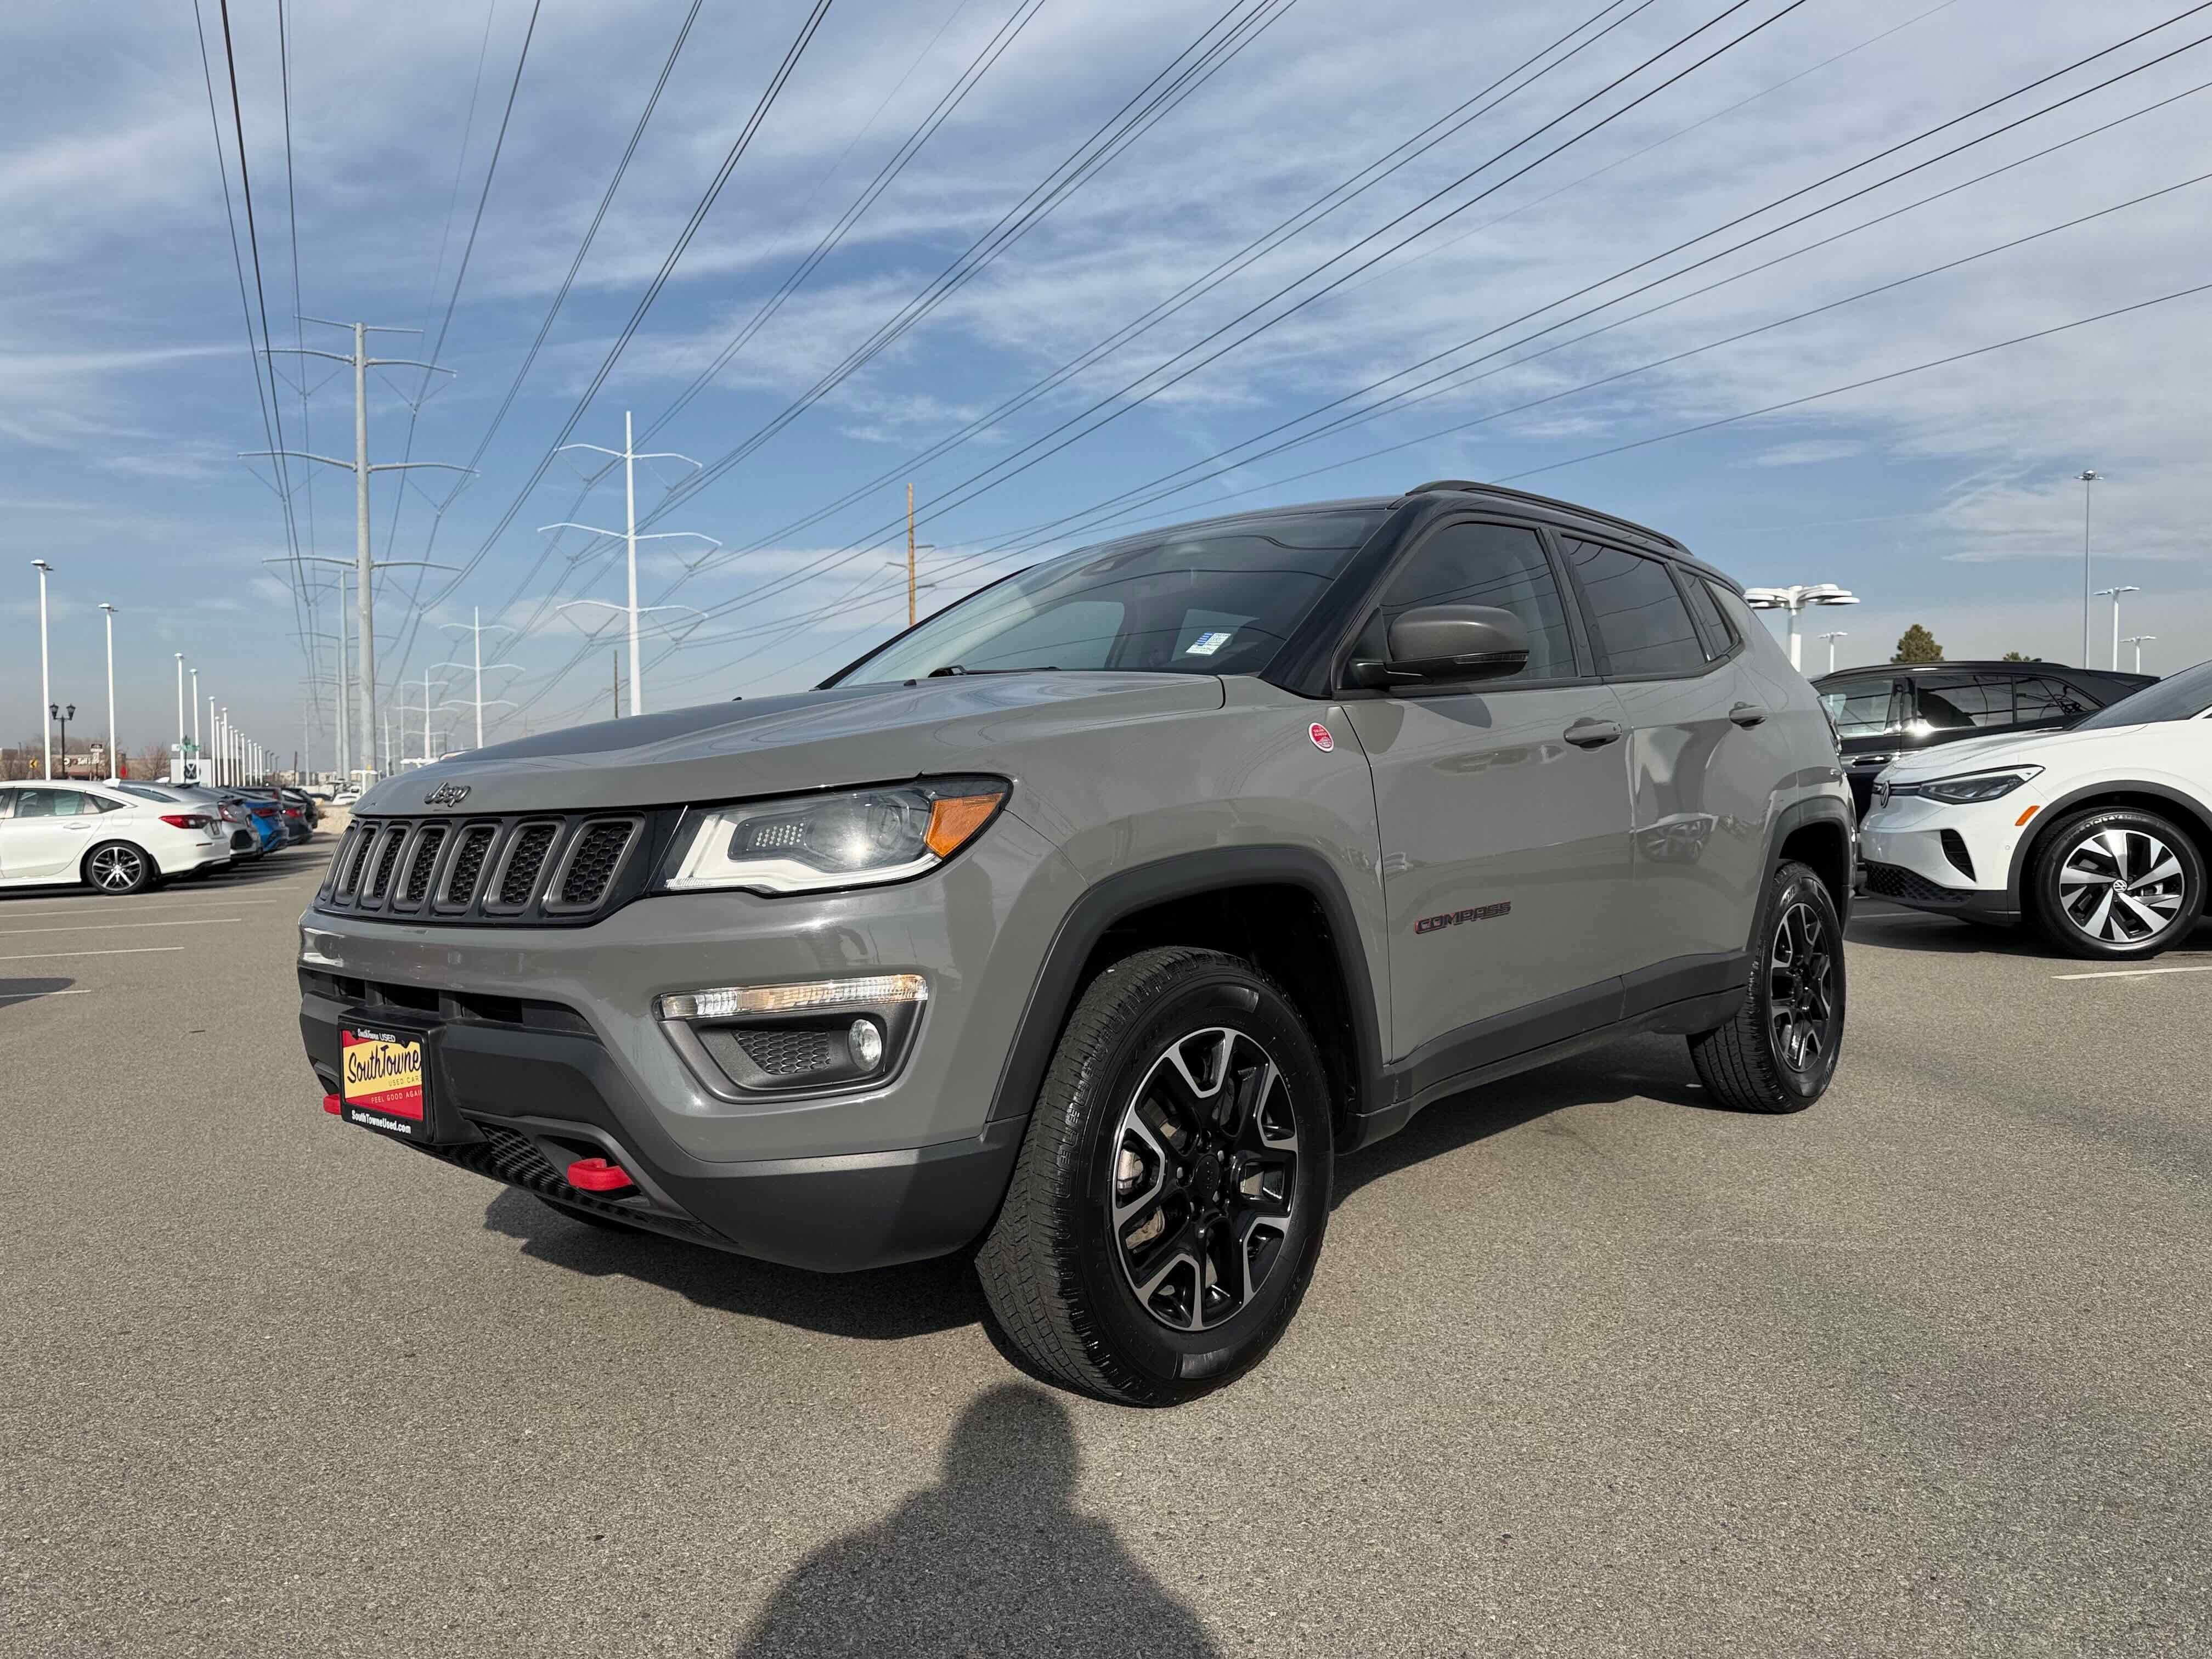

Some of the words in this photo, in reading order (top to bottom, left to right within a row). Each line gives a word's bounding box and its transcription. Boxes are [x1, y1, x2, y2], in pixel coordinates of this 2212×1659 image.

[424, 781, 471, 808] Jeep
[1415, 901, 1511, 934] COMPASS
[379, 1032, 396, 1042] USED
[347, 1044, 421, 1084] SouthTowne
[388, 1078, 404, 1087] USED
[386, 1092, 403, 1102] GOOD
[351, 1109, 411, 1134] SouthTowneUsed.com
